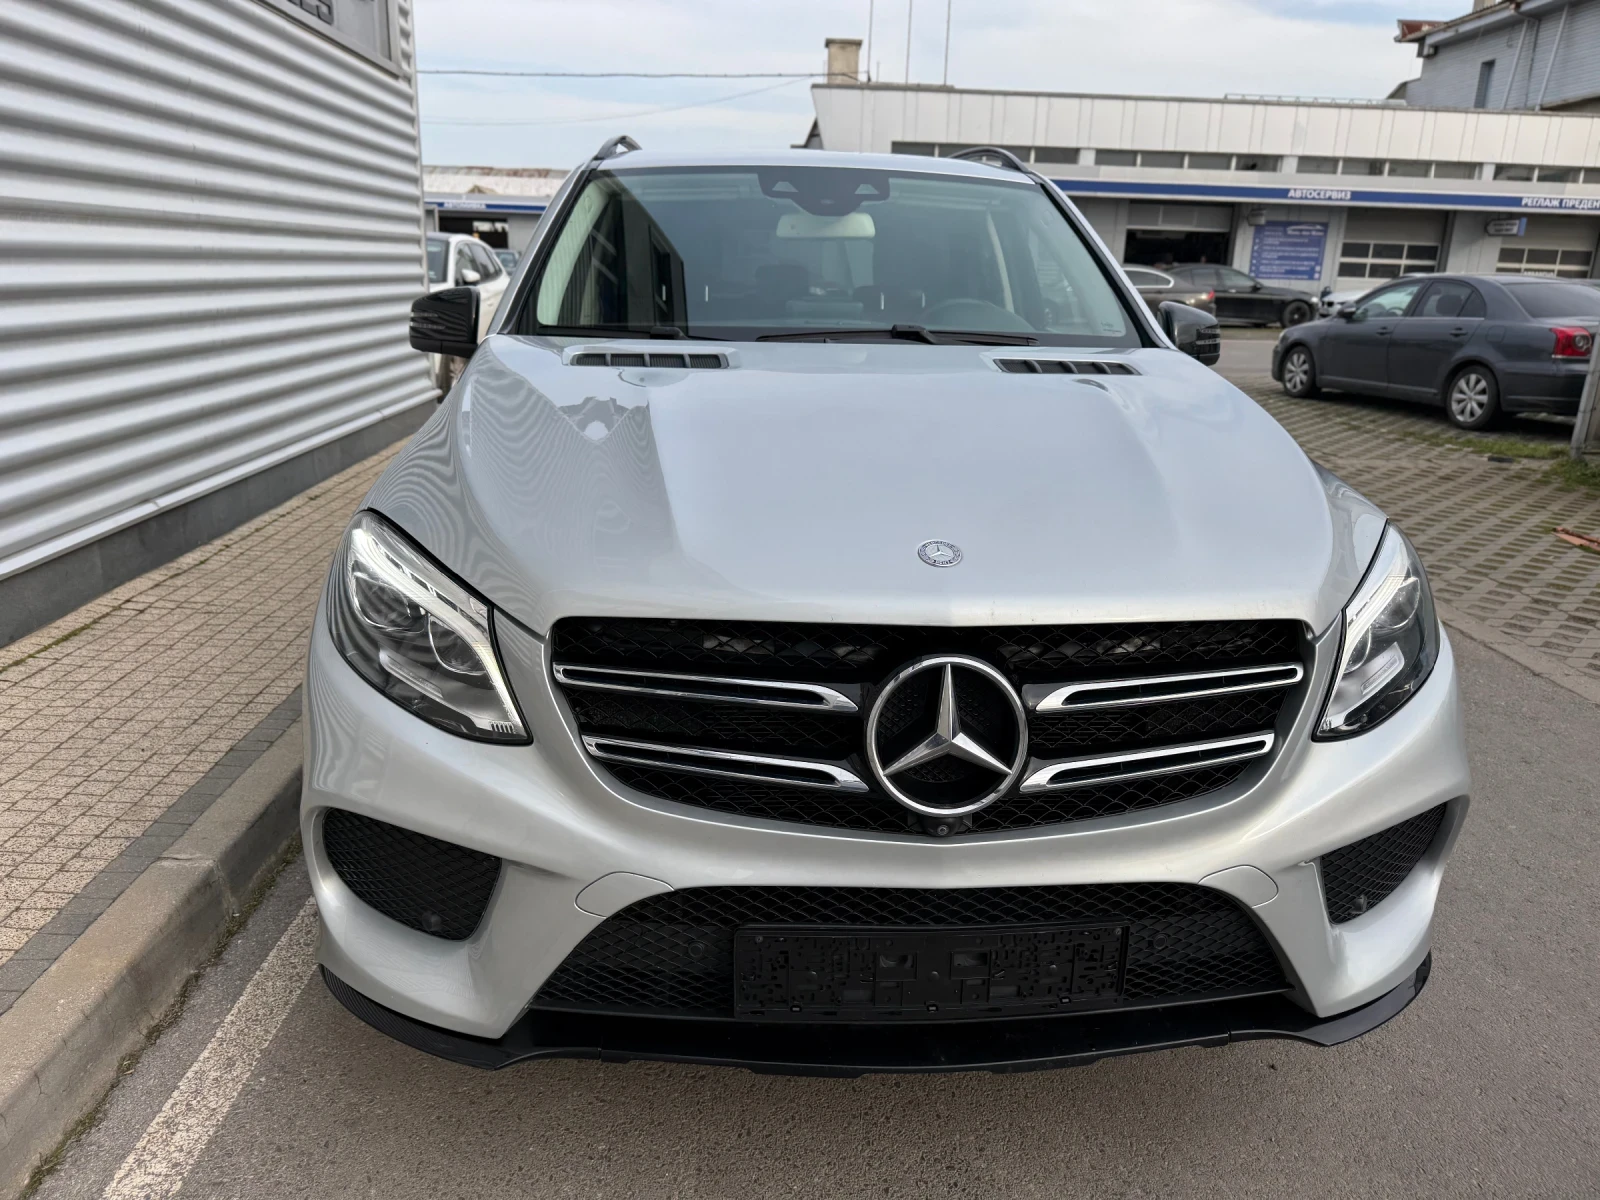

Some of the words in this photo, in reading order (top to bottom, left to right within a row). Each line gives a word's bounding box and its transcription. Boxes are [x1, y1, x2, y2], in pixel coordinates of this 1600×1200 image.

[1288, 189, 1351, 200] АВТОСЕРВИЗ
[1521, 197, 1560, 207] РЕГЛАЖ
[1562, 198, 1600, 209] ПРЕДЕН
